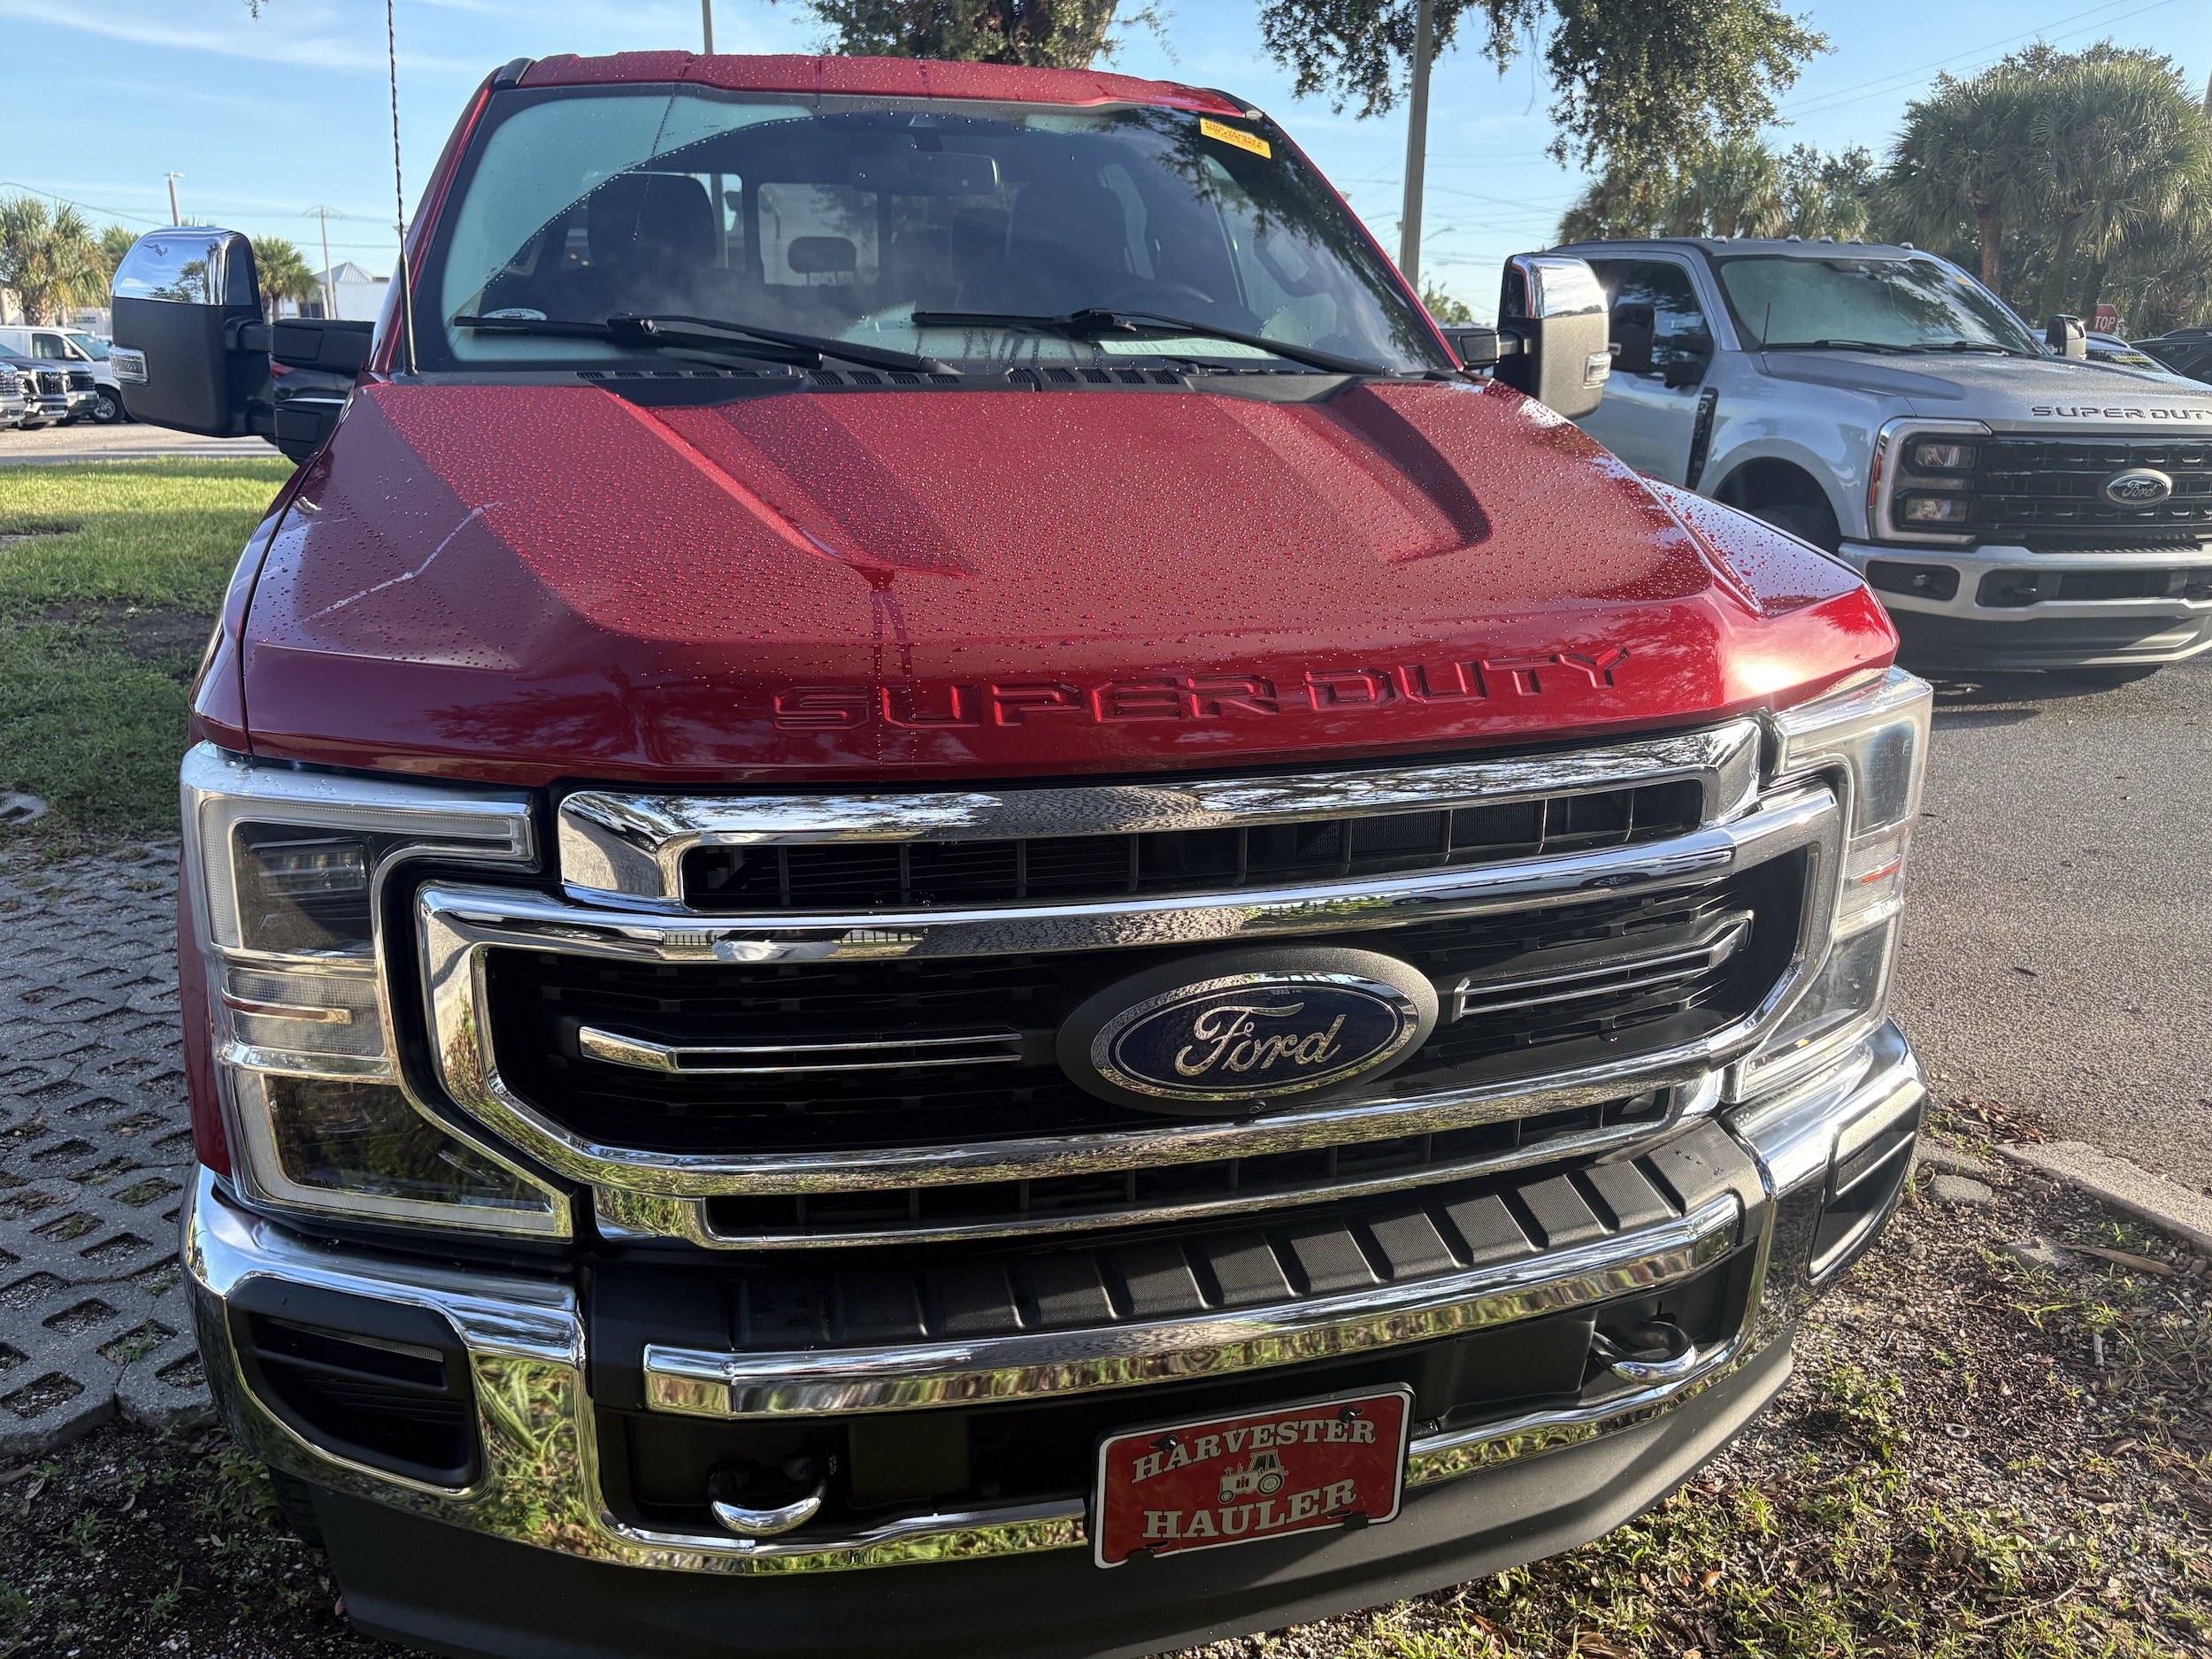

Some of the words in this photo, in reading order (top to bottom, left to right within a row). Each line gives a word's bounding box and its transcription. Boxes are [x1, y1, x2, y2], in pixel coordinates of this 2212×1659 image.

[2094, 316, 2116, 330] TOP
[2031, 406, 2146, 419] SUPER
[2122, 480, 2157, 499] Ford
[772, 673, 1280, 730] SUPER
[1304, 647, 1630, 712] DUTY
[1174, 1002, 1347, 1077] Ford
[1131, 1417, 1377, 1485] HARVESTER
[1141, 1479, 1358, 1540] HAULER
